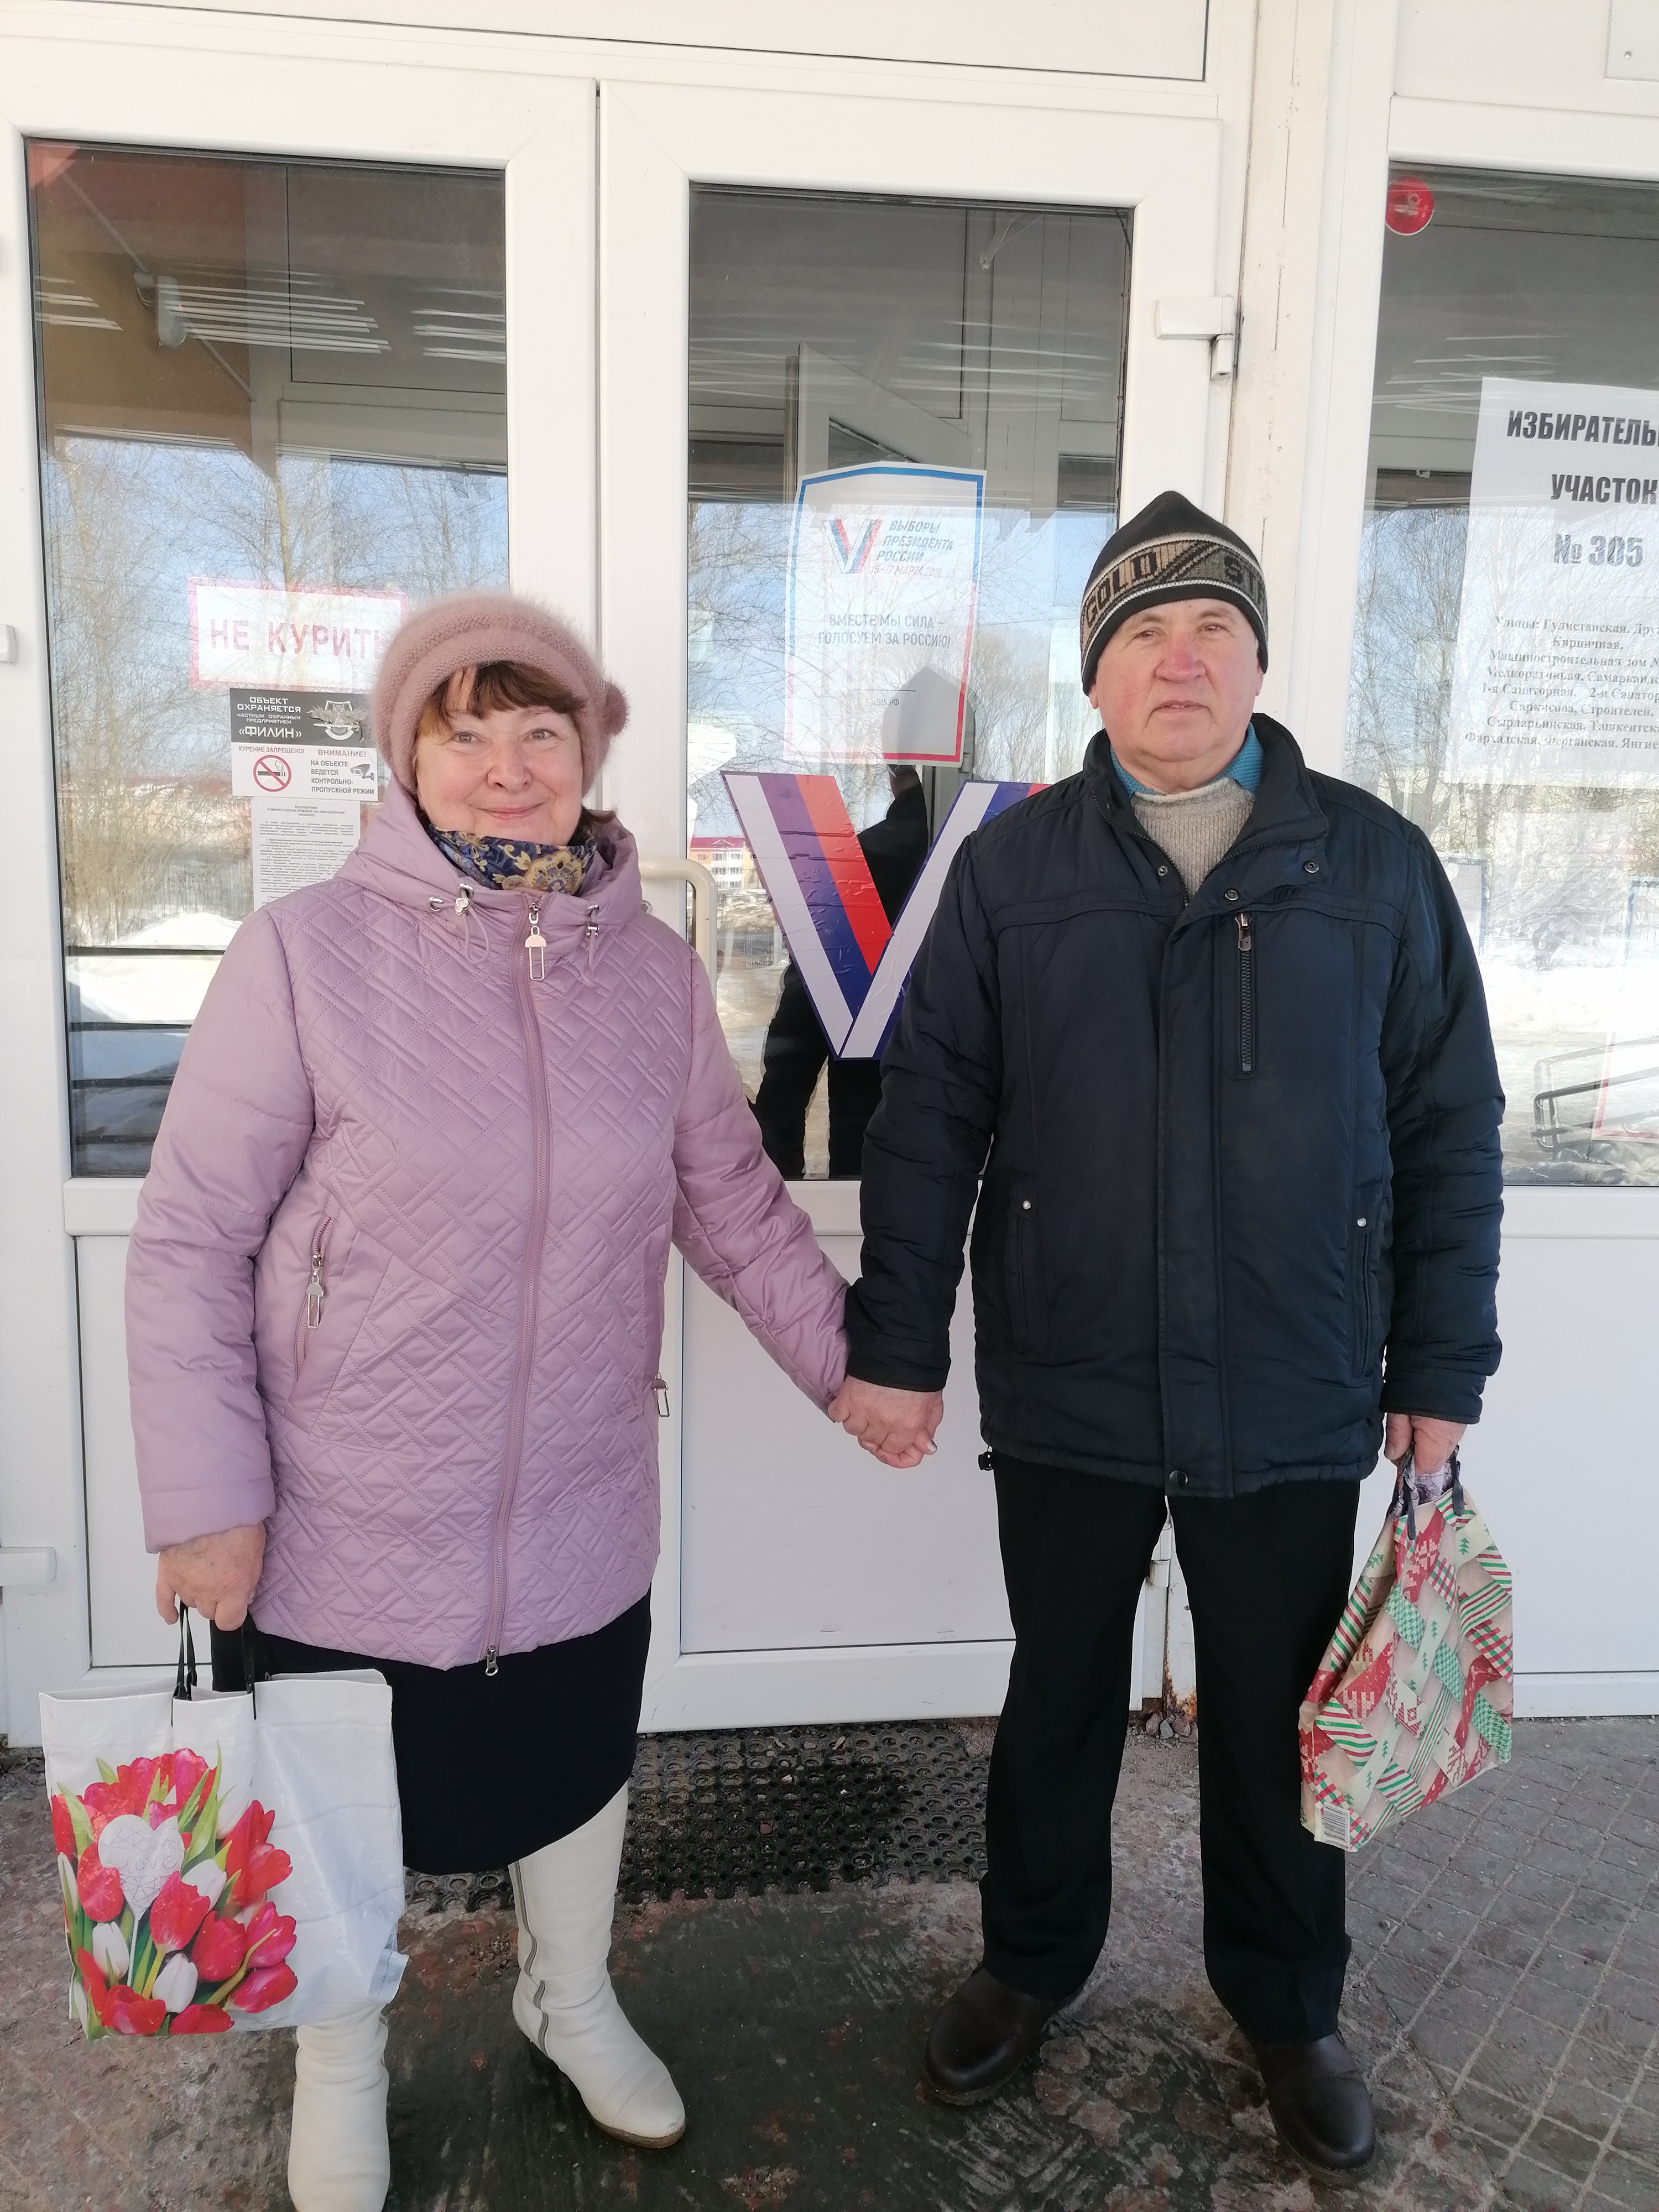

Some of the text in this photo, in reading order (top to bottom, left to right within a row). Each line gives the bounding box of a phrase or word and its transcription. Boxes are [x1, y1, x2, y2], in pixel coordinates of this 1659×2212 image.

[1506, 409, 1659, 447] ИЗБИРАТЕЛЬ
[1550, 473, 1658, 505] УЧАСТОК
[888, 520, 941, 534] ВЫБОРЫ
[882, 535, 954, 550] ПРЕЗИДЕНТА
[875, 550, 925, 562] РОССИИ
[1553, 534, 1644, 567] № 305
[895, 565, 924, 576] МАРТА
[924, 567, 942, 577] 2024
[1086, 552, 1157, 628] GOLD
[829, 614, 876, 627] ВМЕСТЕ
[880, 614, 900, 627] МЫ
[904, 615, 934, 629] СИЛА
[1495, 616, 1539, 629] Улицы:
[1543, 619, 1630, 634] Гулистанская,
[210, 618, 250, 651] НЕ
[818, 632, 951, 647] ГОЛОСУЕМ ЗА РОССИЮ!
[1552, 635, 1623, 650] Кирпичная,
[1489, 649, 1621, 666] Машиностроительная
[1482, 682, 1499, 693] 1-я
[1589, 687, 1607, 698] 2-я
[237, 703, 301, 713] ОХРАНЯЕТСЯ
[249, 696, 288, 705] ОБЪЕКТ
[1580, 703, 1654, 718] Строителей,
[238, 726, 302, 738] «ФИЛИН»
[1591, 719, 1659, 733] Ташкентск
[317, 749, 367, 758] ВНИМАНИЕ!
[311, 786, 352, 794] ПРОПУСКНОЙ
